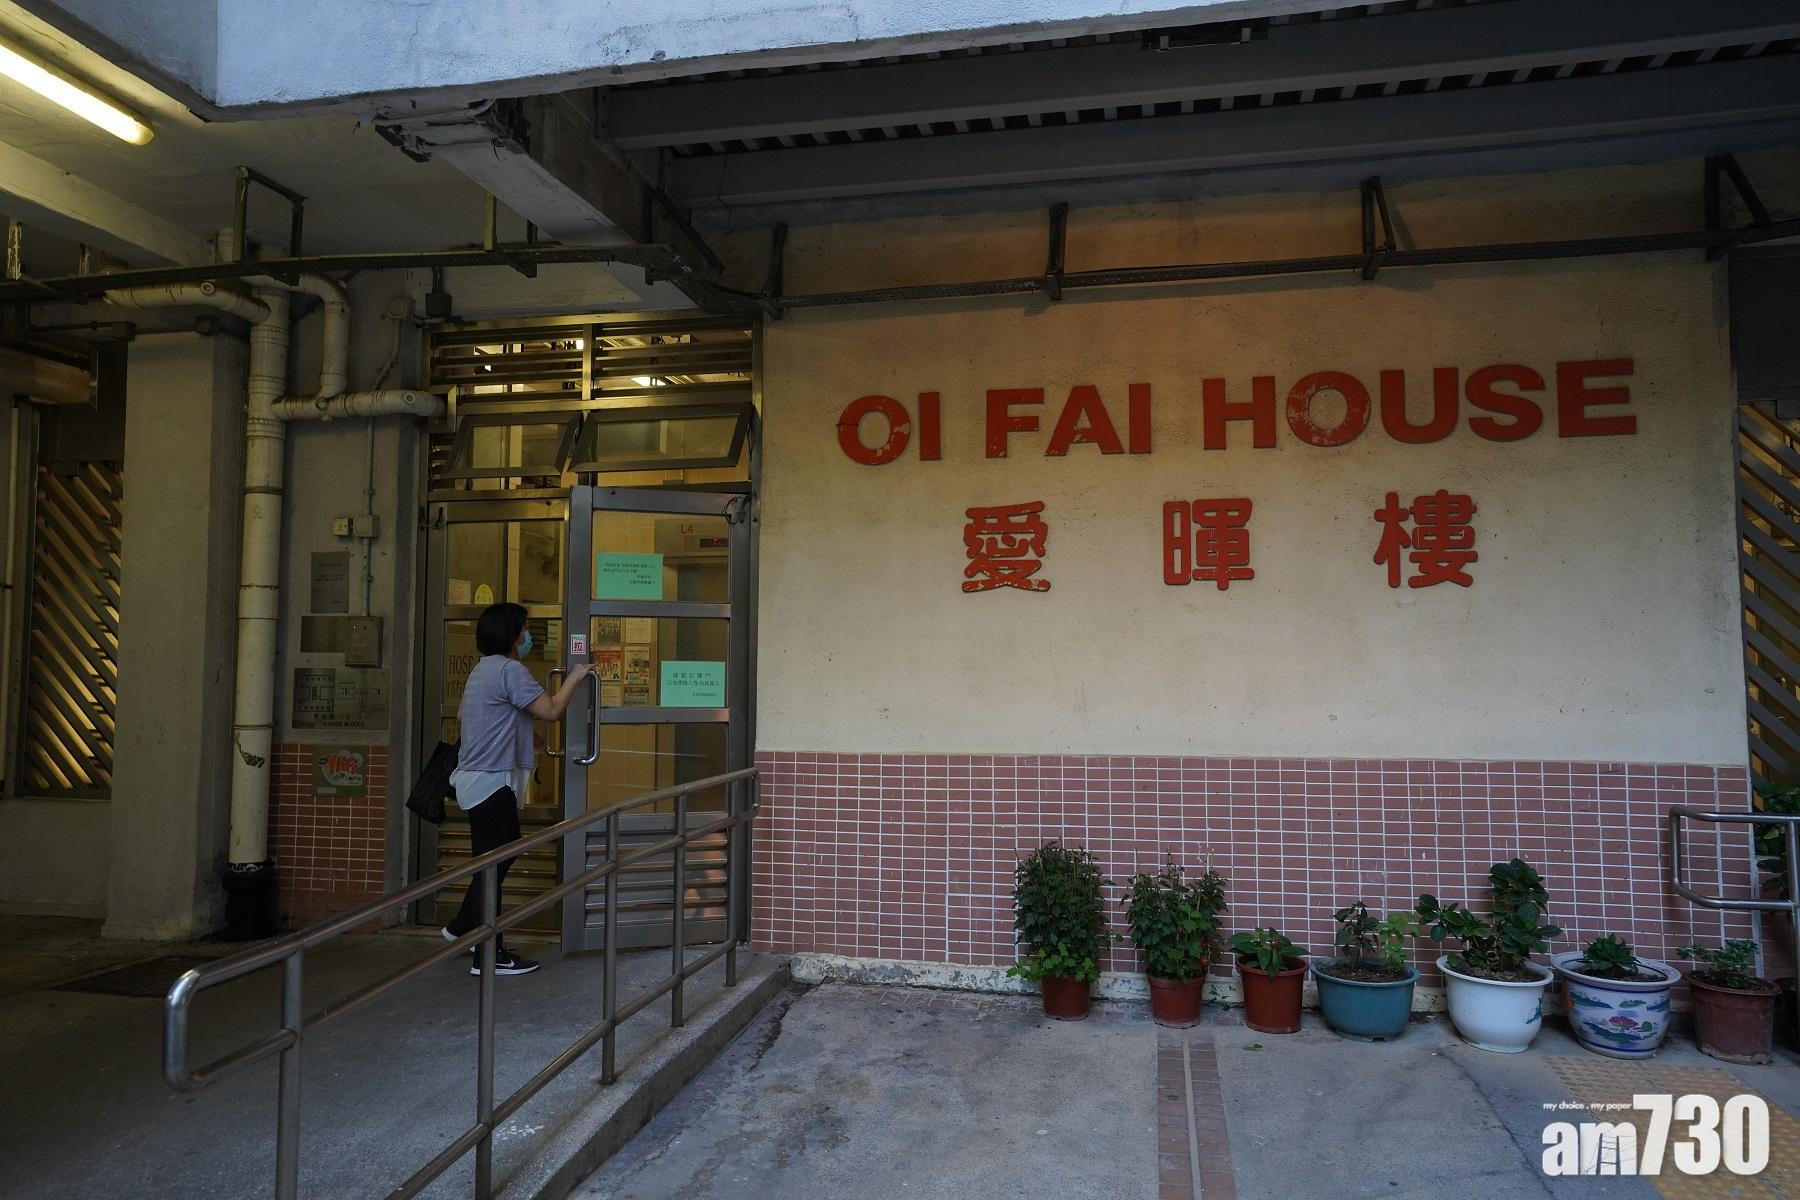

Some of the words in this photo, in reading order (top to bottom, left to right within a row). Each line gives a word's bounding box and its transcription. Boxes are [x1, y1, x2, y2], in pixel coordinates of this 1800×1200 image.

[837, 391, 942, 466] OI
[985, 382, 1152, 459] FAI
[1202, 357, 1637, 451] HOUSE
[961, 488, 1479, 593] 愛暉樓
